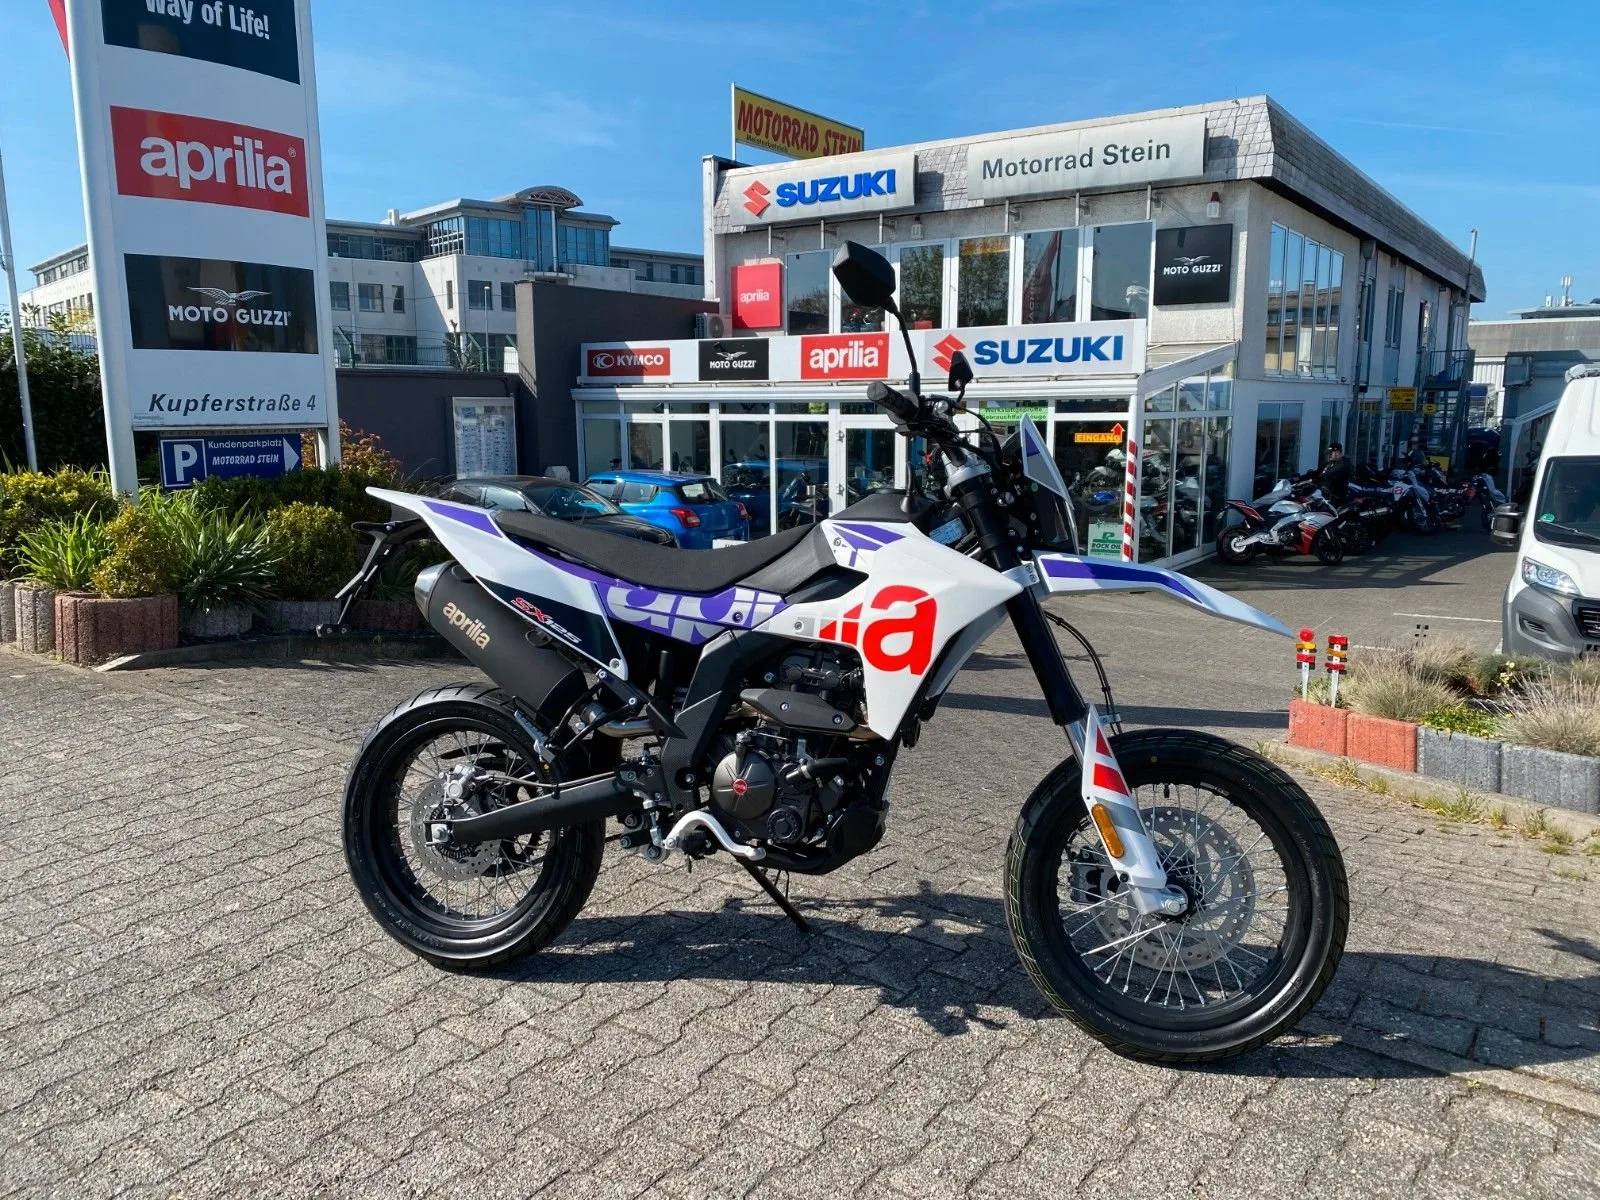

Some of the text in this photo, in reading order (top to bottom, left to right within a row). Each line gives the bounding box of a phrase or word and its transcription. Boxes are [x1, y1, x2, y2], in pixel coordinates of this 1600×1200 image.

[201, 1, 223, 26] of
[229, 4, 269, 40] Life!
[737, 99, 819, 153] MOTORRAD
[140, 136, 292, 194] aprilia
[982, 139, 1170, 180] Motorrad Stein
[776, 169, 896, 207] SUZUKI
[1163, 263, 1221, 275] MOTO GUZZI
[740, 289, 770, 303] aprilia
[168, 305, 289, 326] MOTO GUZZI
[616, 354, 664, 367] KYMCO
[809, 340, 879, 374] aprilia
[974, 335, 1124, 366] SUZUKI
[709, 359, 756, 369] MOTO GUZZI
[149, 394, 316, 416] Kupferstraße 4
[208, 439, 282, 449] Kundenparkplatz
[1076, 433, 1121, 442] EINGANG
[174, 443, 198, 482] P
[212, 453, 279, 466] MOTORRAD STEIN
[442, 601, 490, 650] aprilia
